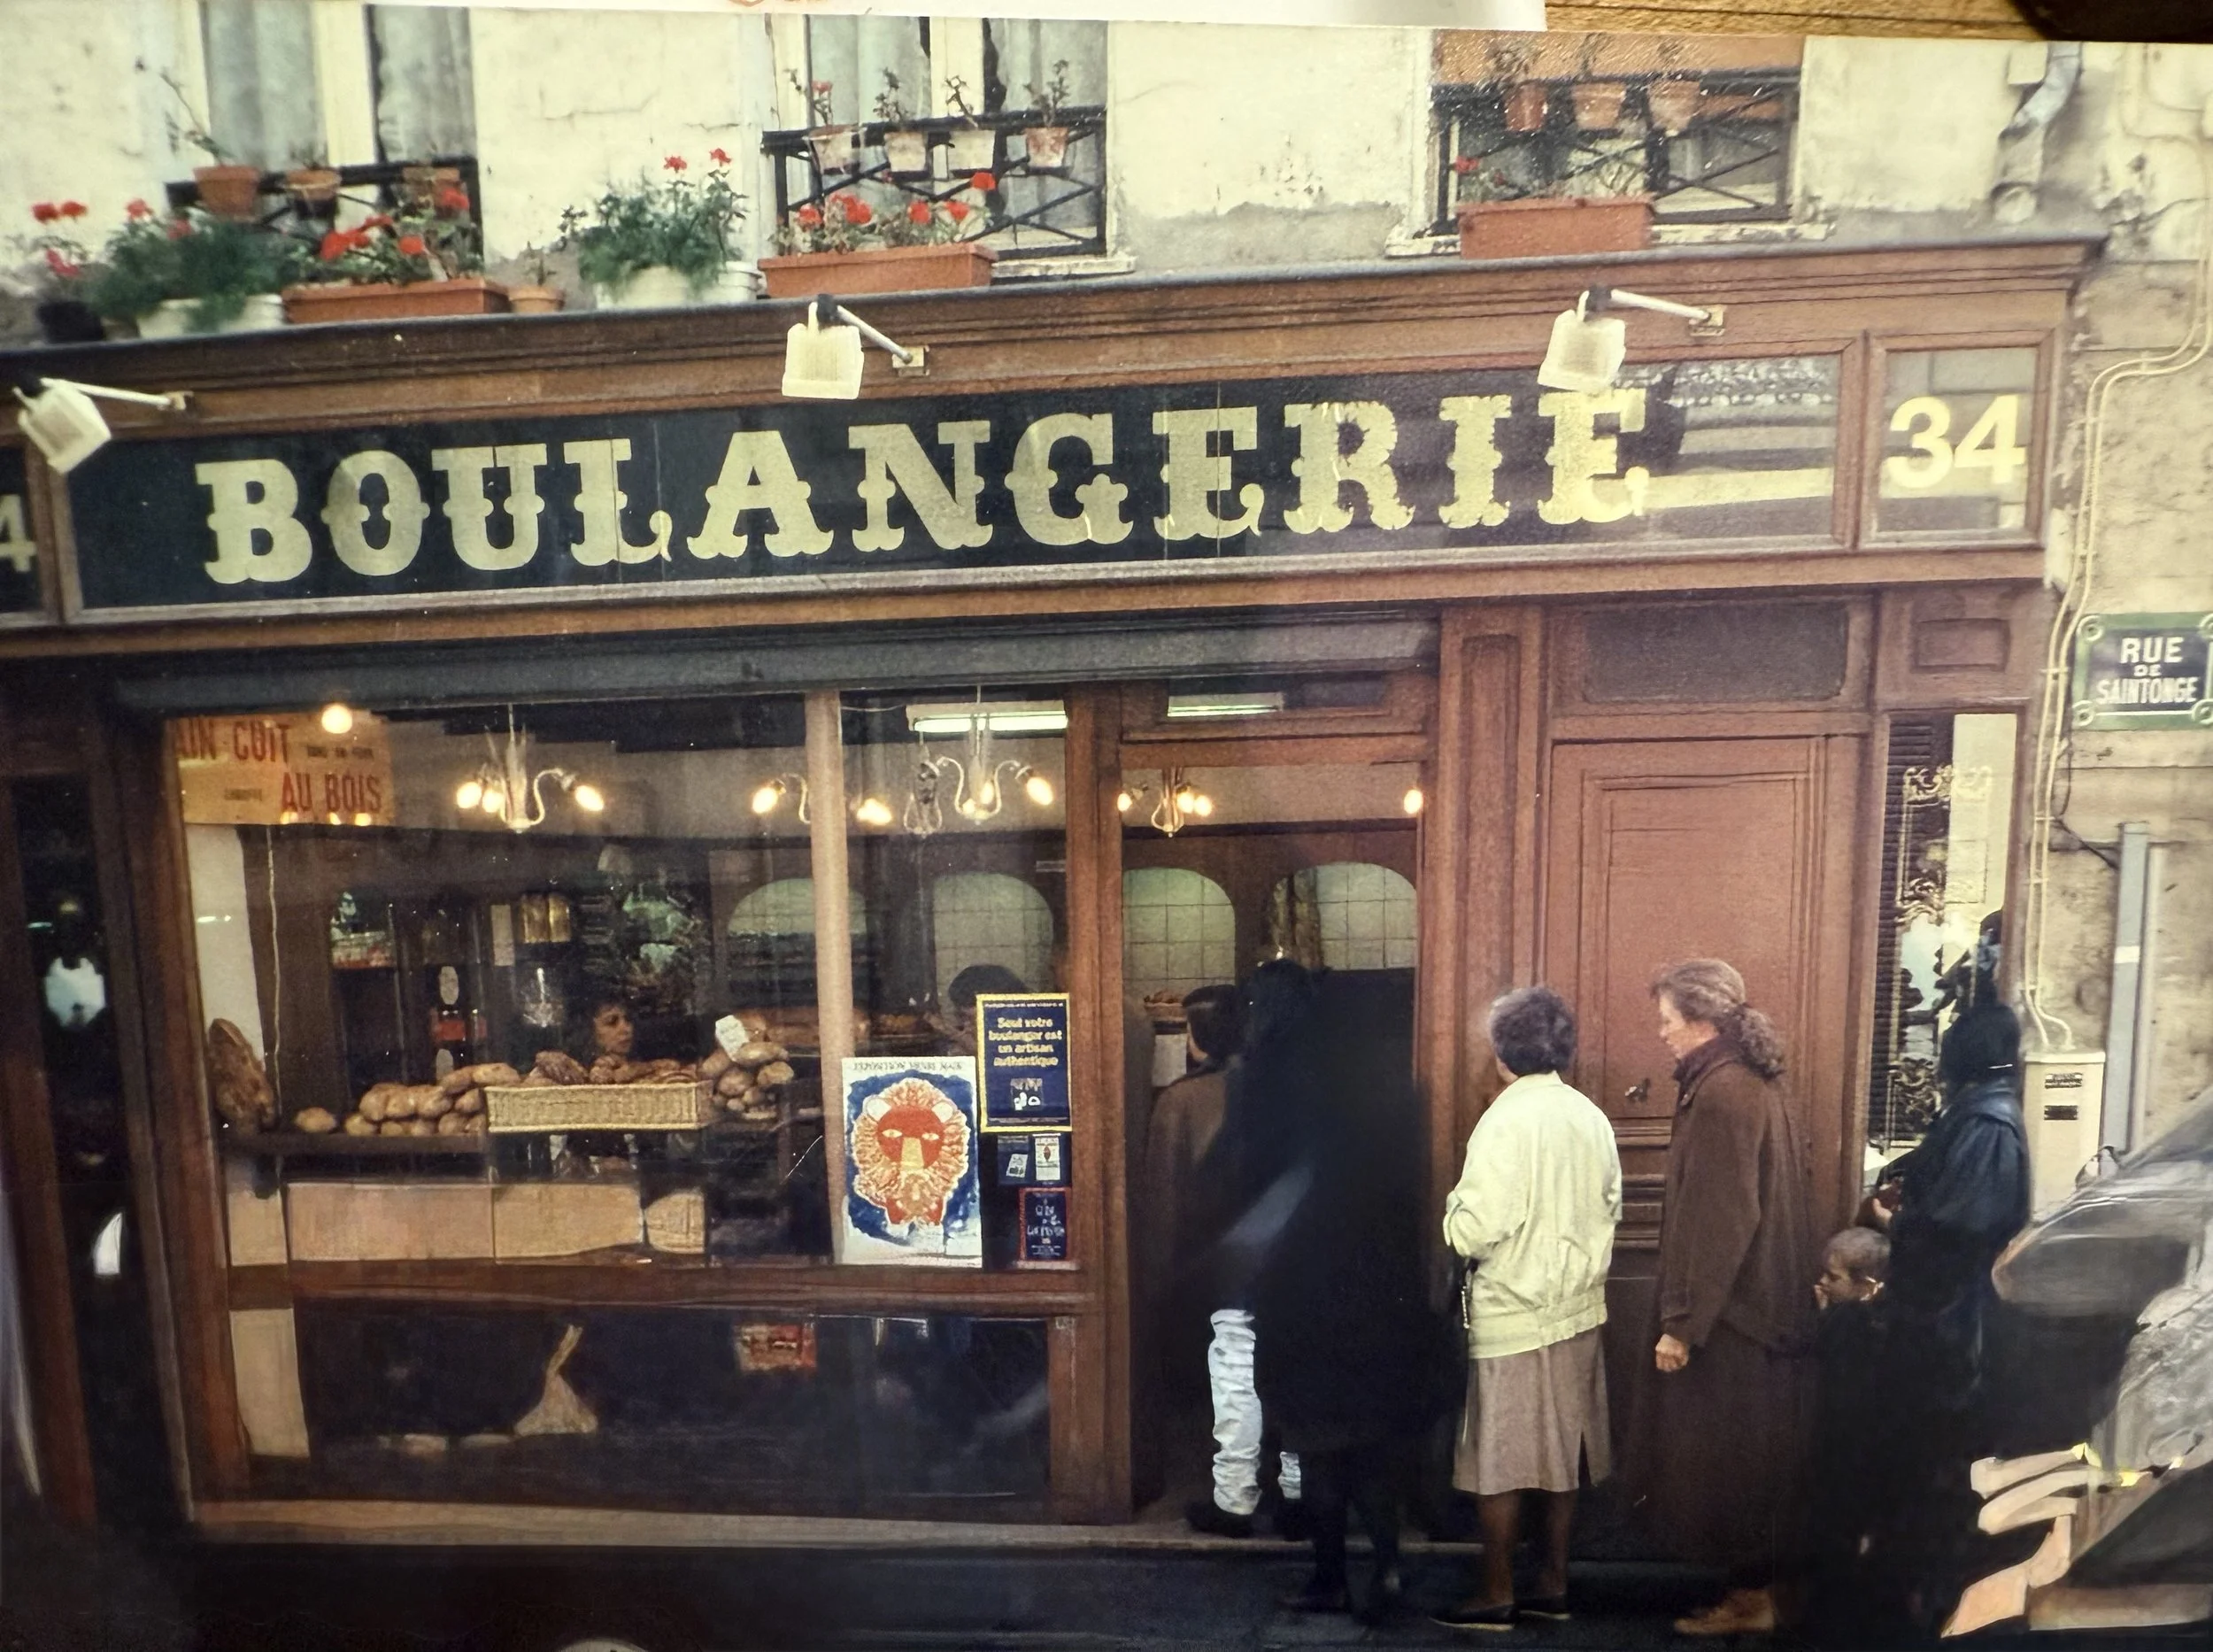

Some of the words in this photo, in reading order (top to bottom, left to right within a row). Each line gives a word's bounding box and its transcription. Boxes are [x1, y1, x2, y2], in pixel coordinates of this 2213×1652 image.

[1888, 394, 2026, 488] 34
[196, 388, 1648, 584] BOULANGERIE
[2120, 637, 2185, 663] RUE
[2133, 664, 2162, 676] DE
[2096, 676, 2199, 705] SAINTONGE
[281, 772, 312, 813] AU
[325, 772, 382, 813] BOIS
[1024, 1017, 1053, 1028] votre
[988, 1030, 1043, 1042] boulanger
[1014, 1043, 1054, 1054] artisan
[993, 1055, 1059, 1068] authentique
